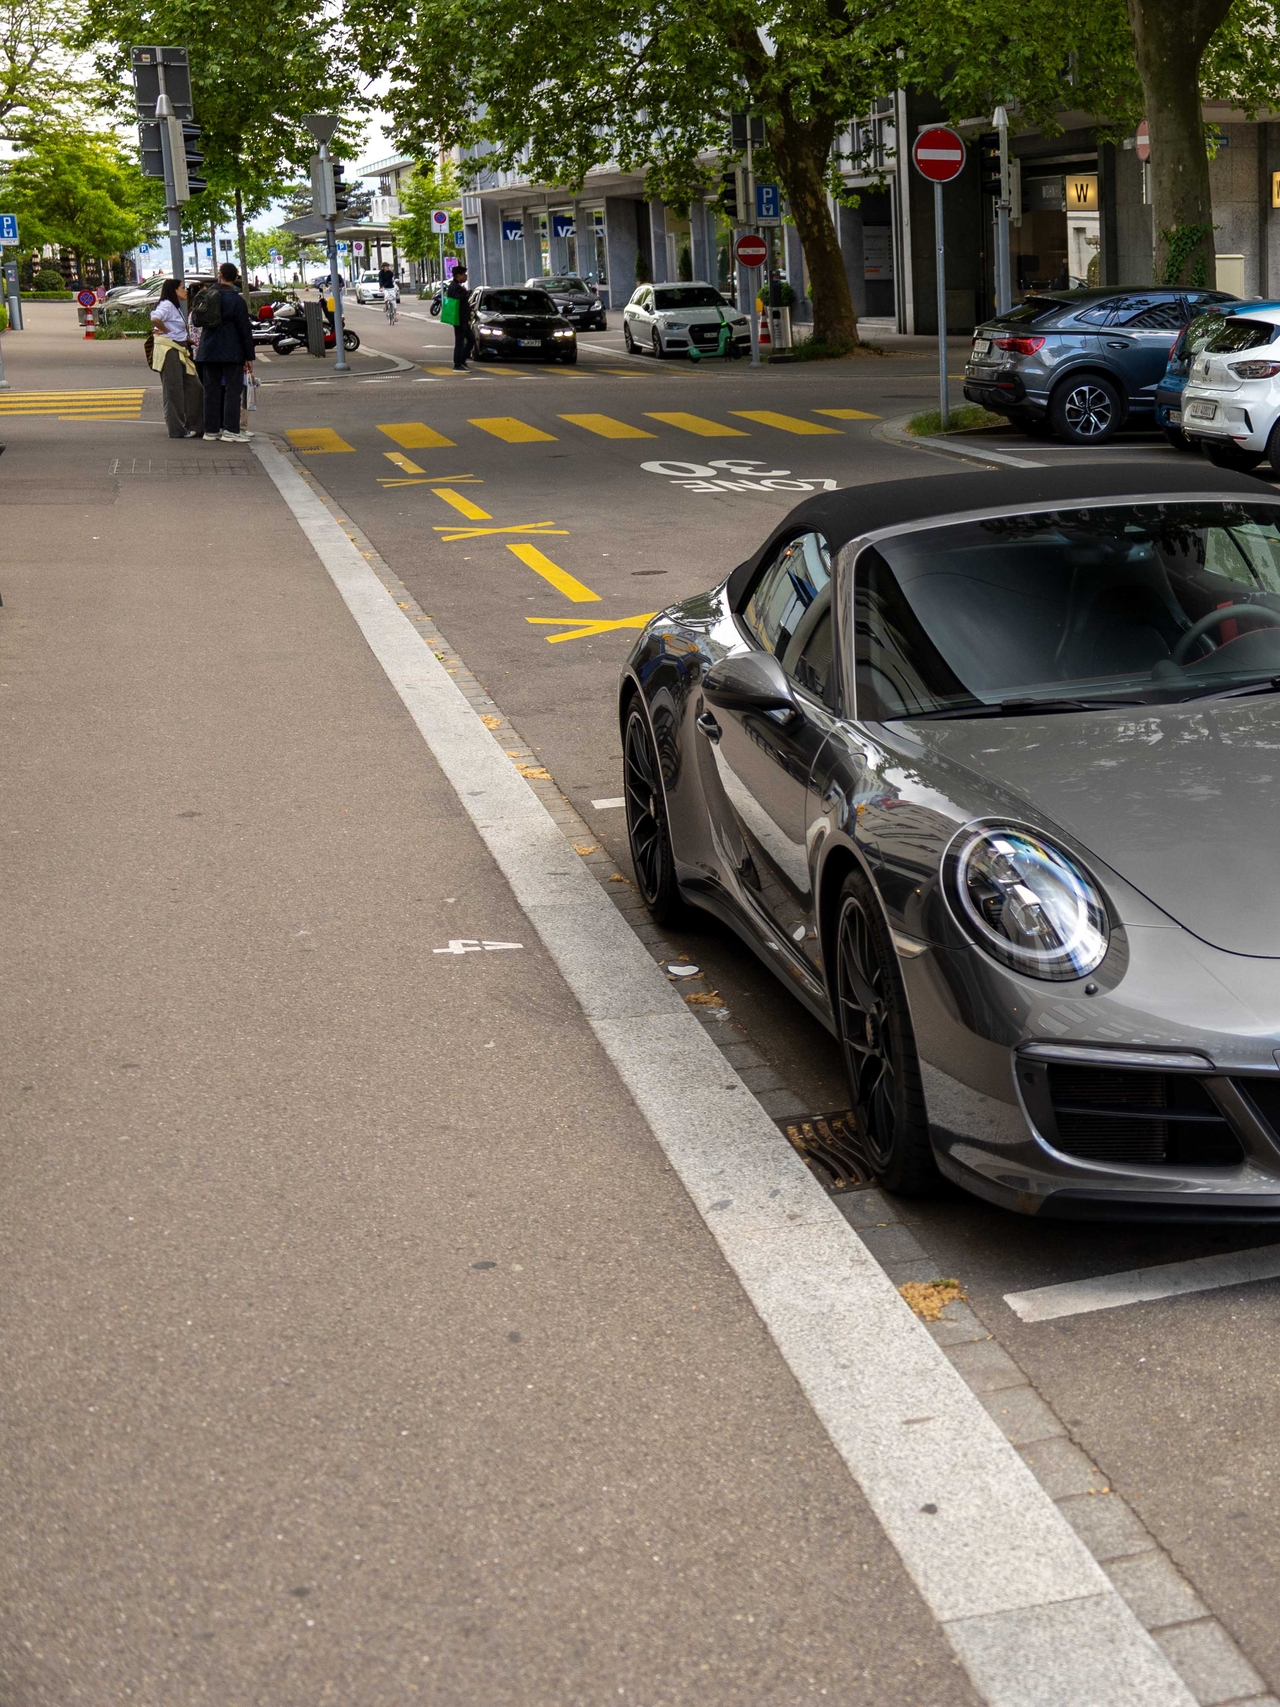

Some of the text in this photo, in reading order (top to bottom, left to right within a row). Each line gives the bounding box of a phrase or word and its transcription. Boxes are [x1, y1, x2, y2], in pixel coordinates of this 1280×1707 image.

[763, 188, 772, 203] P
[1075, 183, 1089, 202] W
[3, 217, 11, 229] P
[506, 229, 522, 240] VZ
[558, 226, 575, 237] VZ
[640, 459, 791, 477] 30
[669, 479, 845, 493] ZONE
